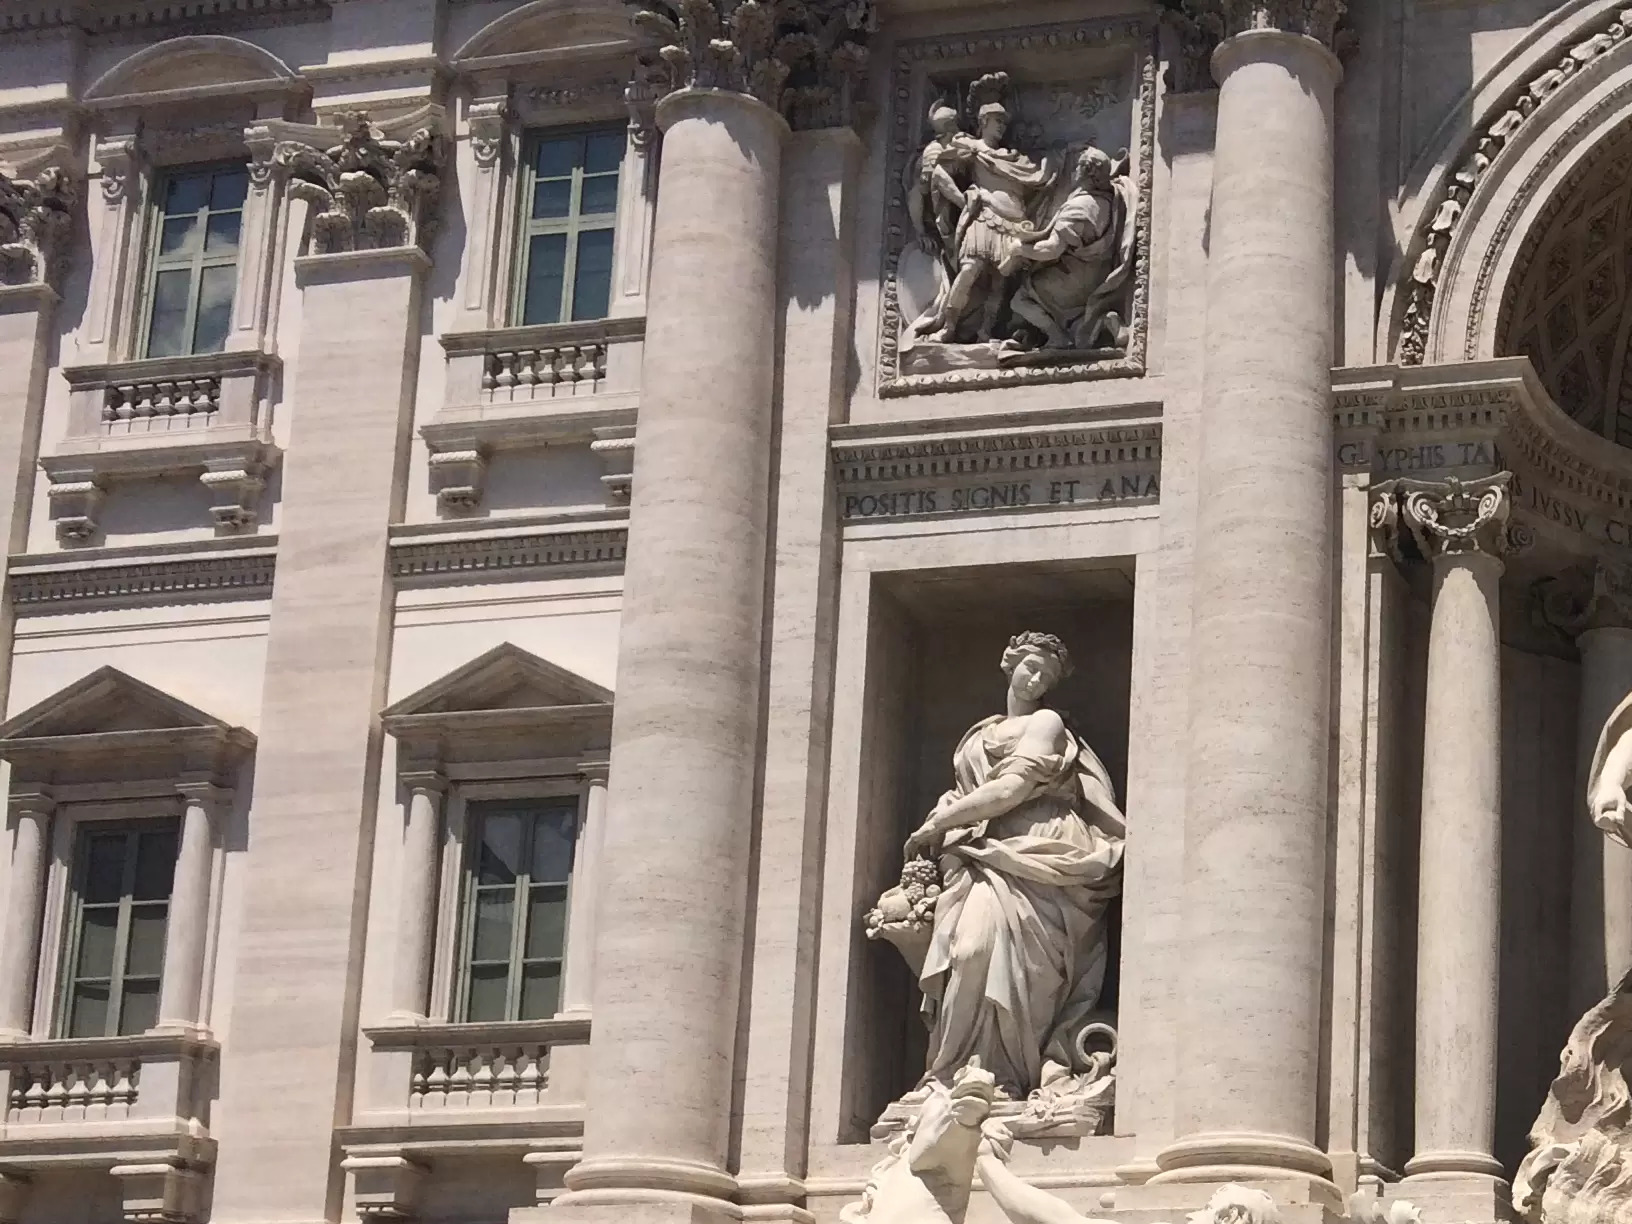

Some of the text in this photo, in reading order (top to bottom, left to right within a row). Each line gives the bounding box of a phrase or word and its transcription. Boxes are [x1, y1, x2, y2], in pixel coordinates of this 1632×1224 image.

[843, 473, 1160, 518] POSITIS SIGNIS ET ANA
[1532, 486, 1588, 532] IVSSV
